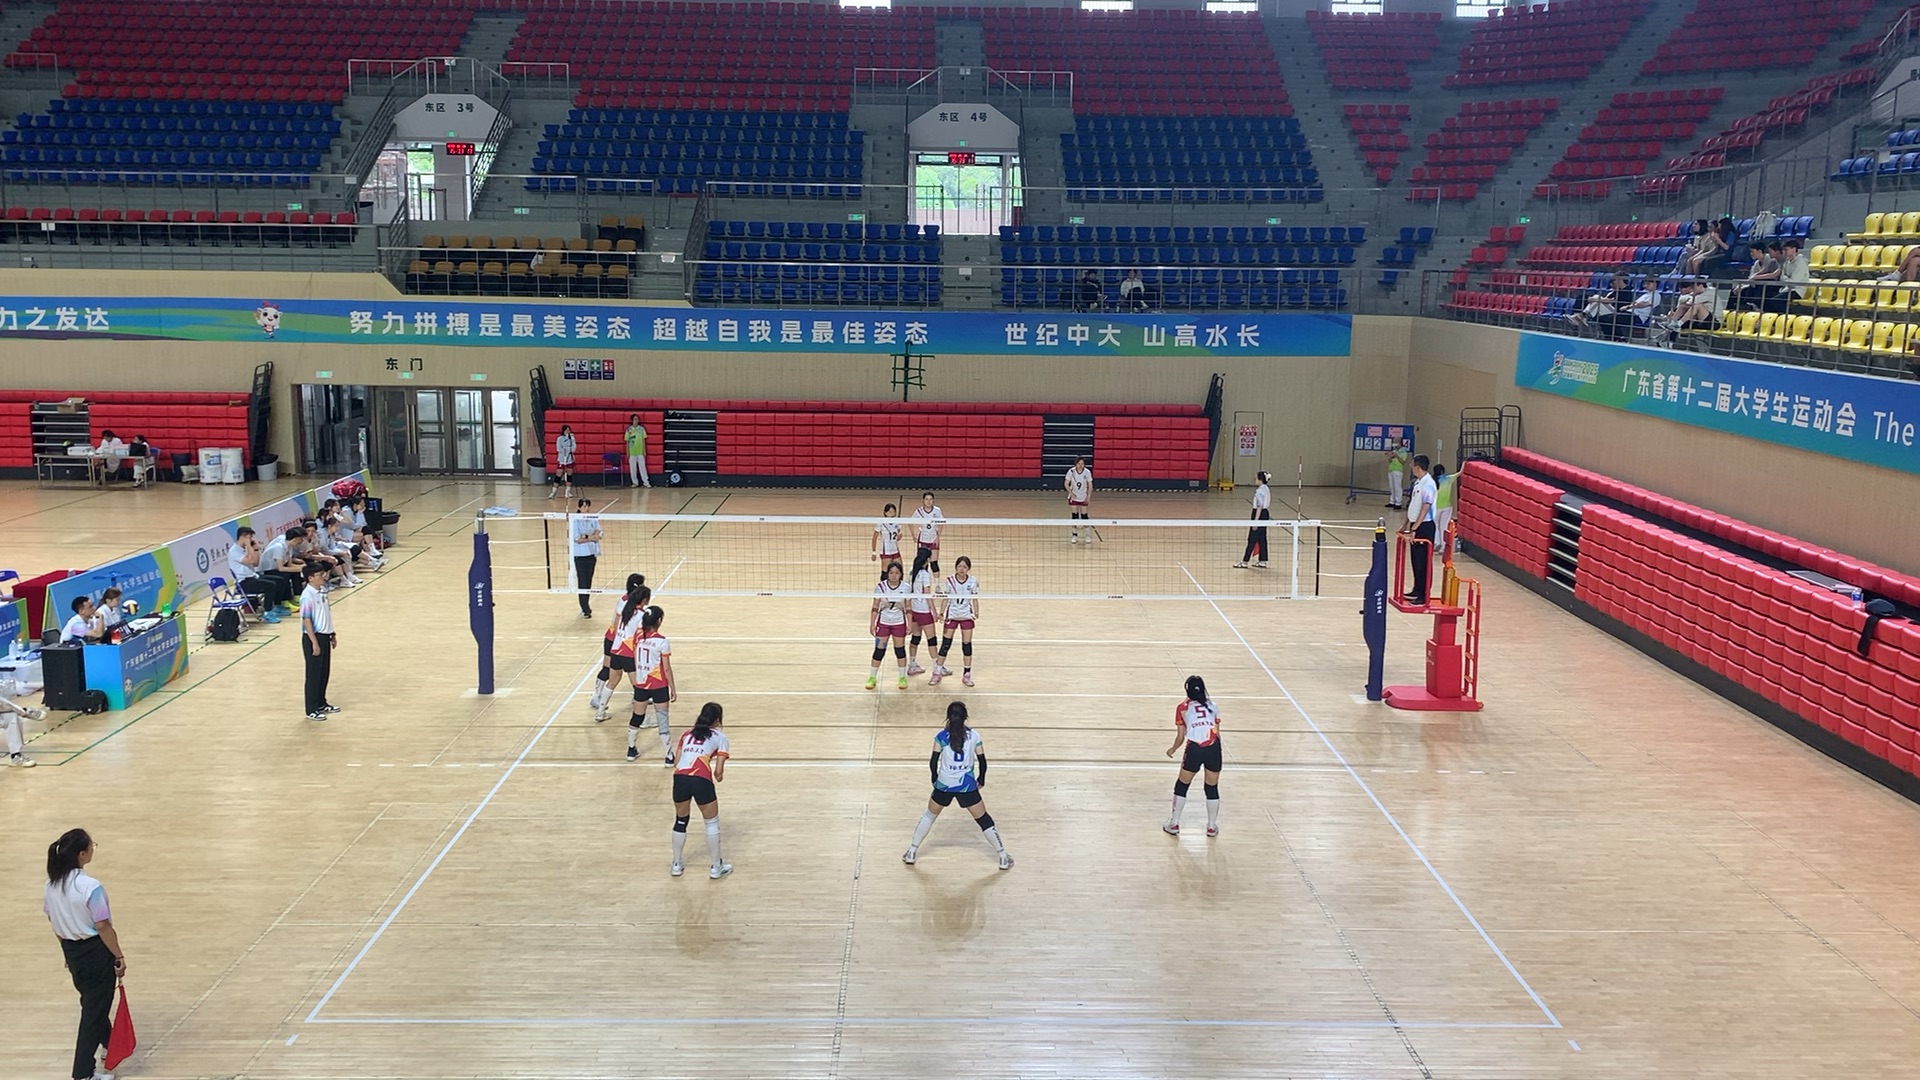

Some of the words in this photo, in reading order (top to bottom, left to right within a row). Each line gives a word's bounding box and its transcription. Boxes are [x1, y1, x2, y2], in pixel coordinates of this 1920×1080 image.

[425, 103, 446, 113] 东区
[457, 103, 474, 113] 3号
[939, 112, 960, 122] 东区
[970, 112, 988, 122] 4号
[0, 306, 110, 331] 力之发达
[349, 310, 632, 340] 努力拼搏是最美姿态
[652, 317, 929, 346] 超越自我是最佳姿态
[1004, 323, 1122, 347] 世纪中大
[1143, 323, 1261, 348] 山高水长
[385, 358, 424, 371] 东门
[1622, 367, 1857, 437] 广东省第十二届大学生运动会
[1872, 410, 1915, 447] The
[1076, 481, 1082, 490] 9
[638, 647, 650, 664] 17
[1195, 704, 1207, 719] 5
